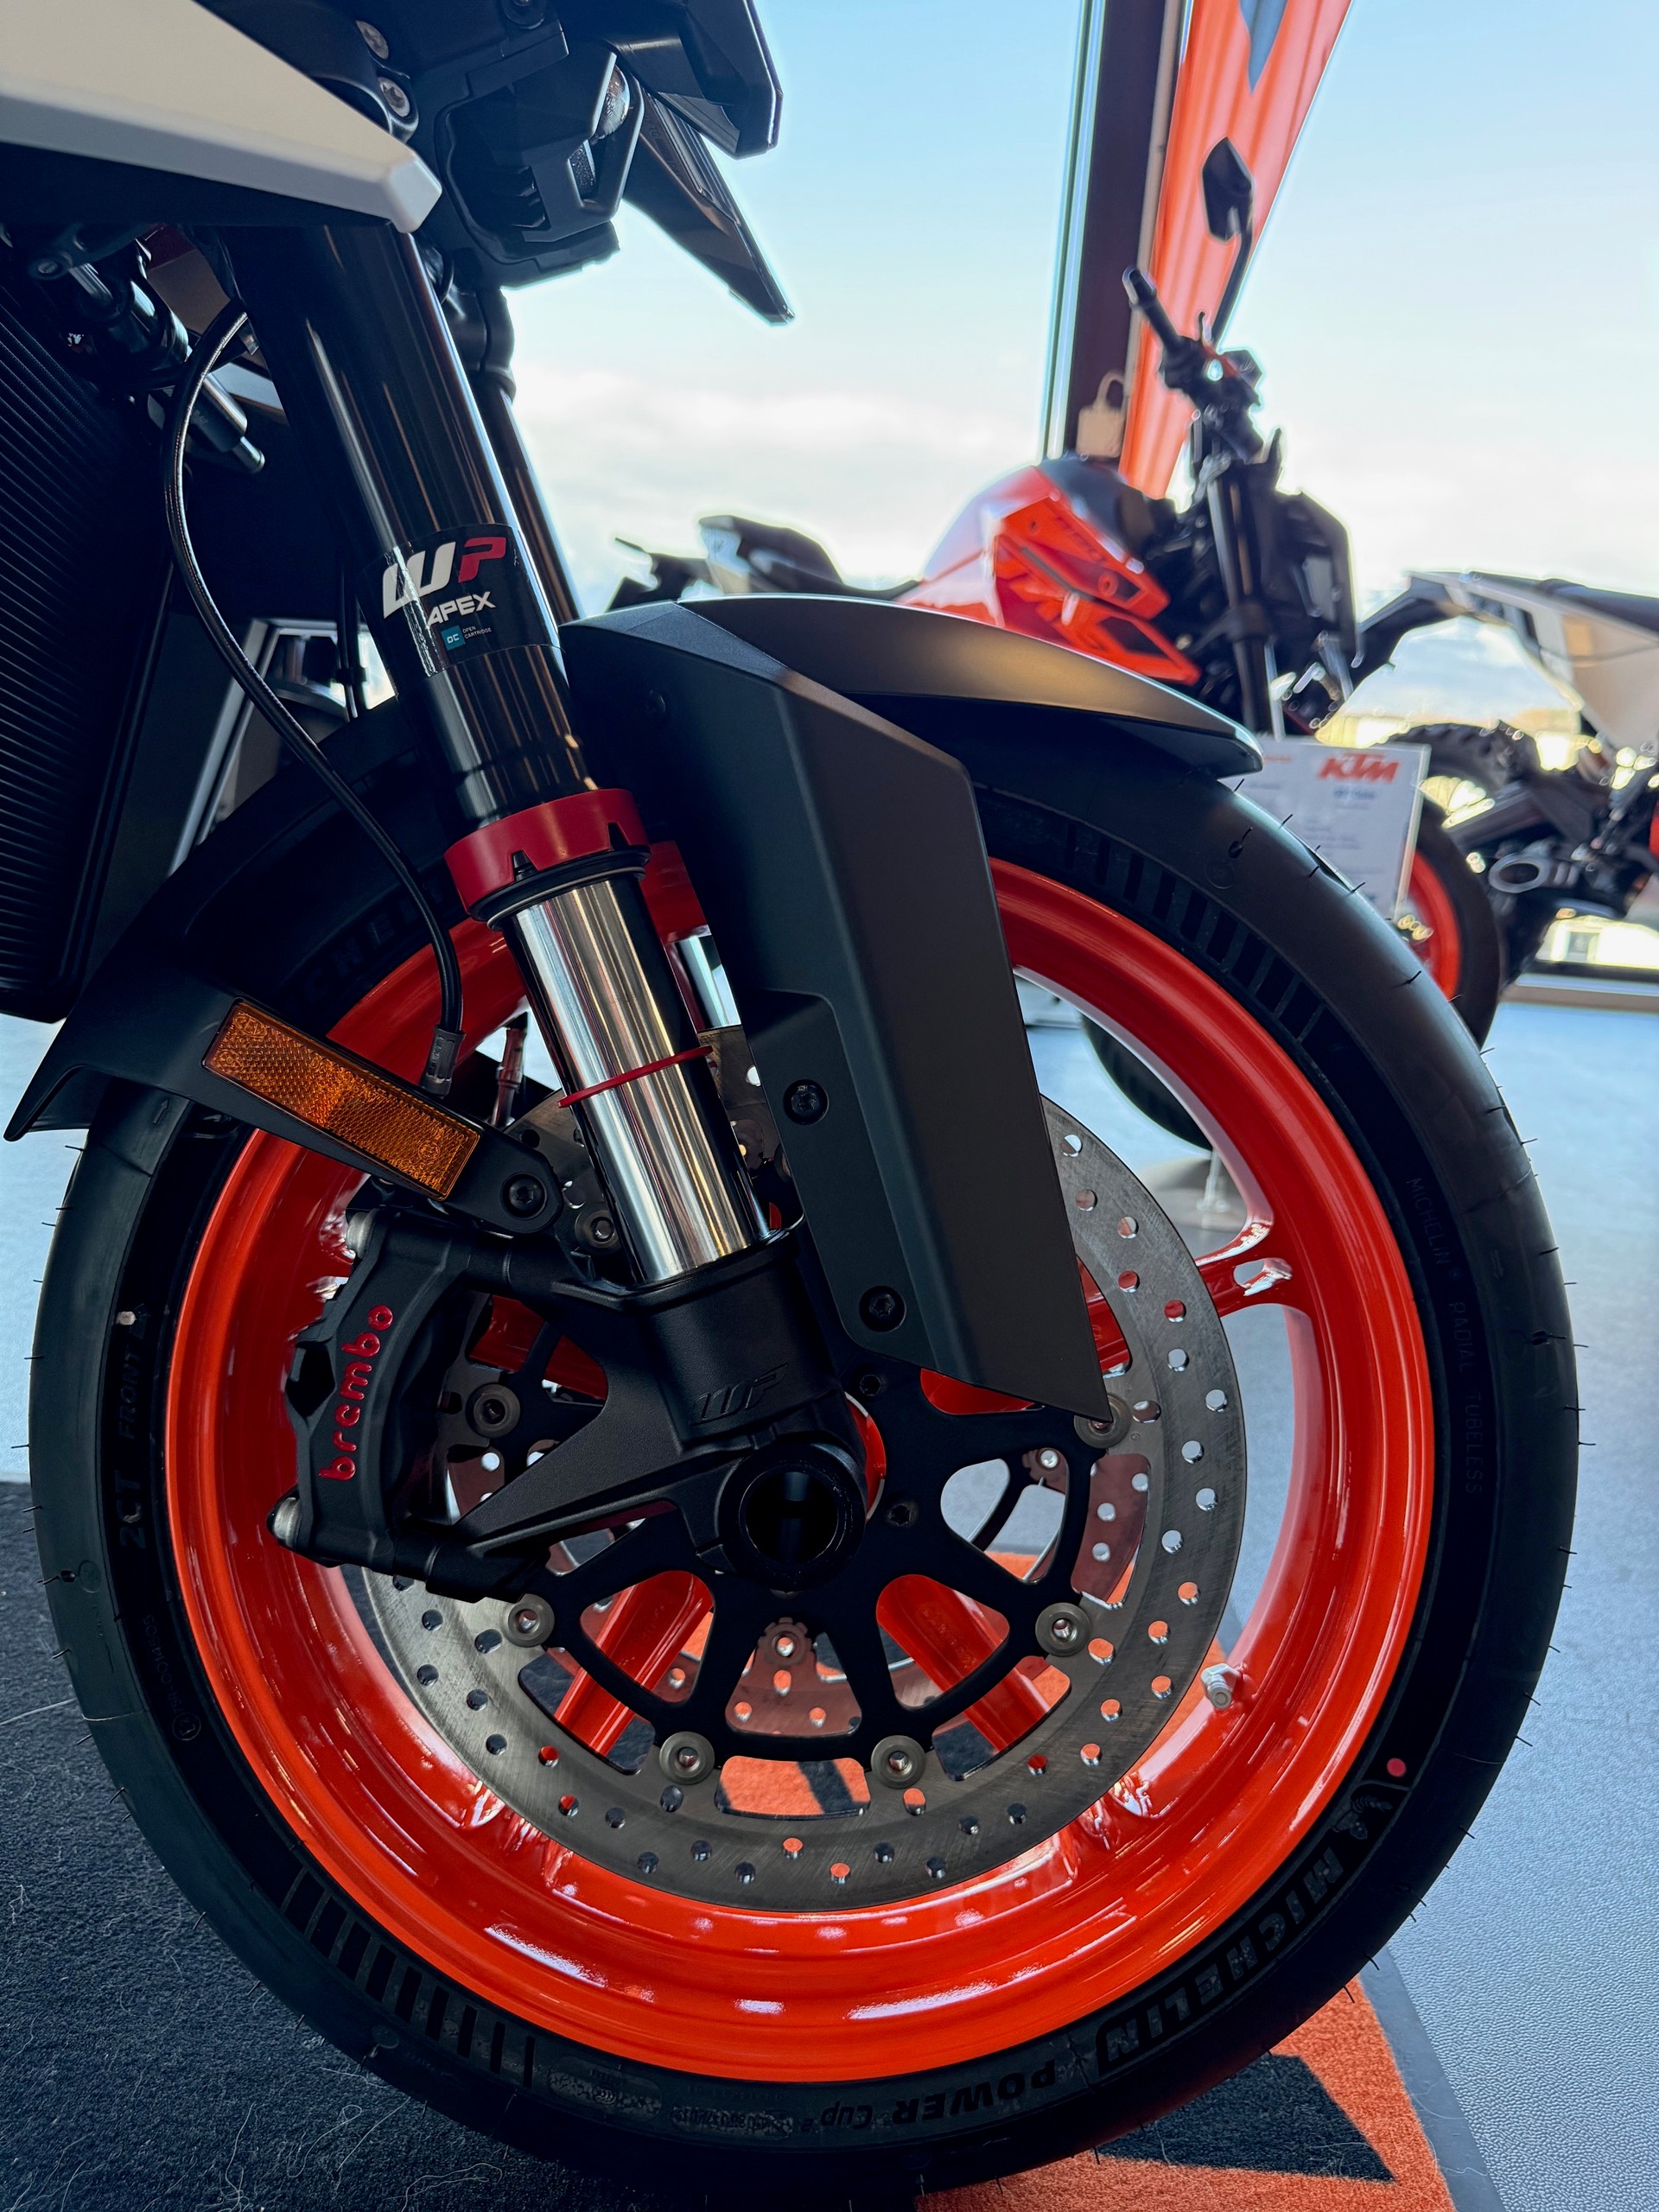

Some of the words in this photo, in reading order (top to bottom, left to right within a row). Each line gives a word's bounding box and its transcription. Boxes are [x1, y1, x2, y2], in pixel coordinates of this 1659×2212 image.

[382, 537, 507, 620] WP
[427, 591, 497, 628] APEX
[1319, 753, 1400, 784] KTM
[118, 1345, 142, 1440] FRONT
[319, 1304, 395, 1482] brembo
[1447, 1301, 1474, 1374] RADIAL
[1464, 1391, 1484, 1495] TUBELESS
[113, 1468, 148, 1551] 2CT
[1105, 1847, 1346, 2063] MICHELIN
[892, 2060, 1056, 2126] POWER
